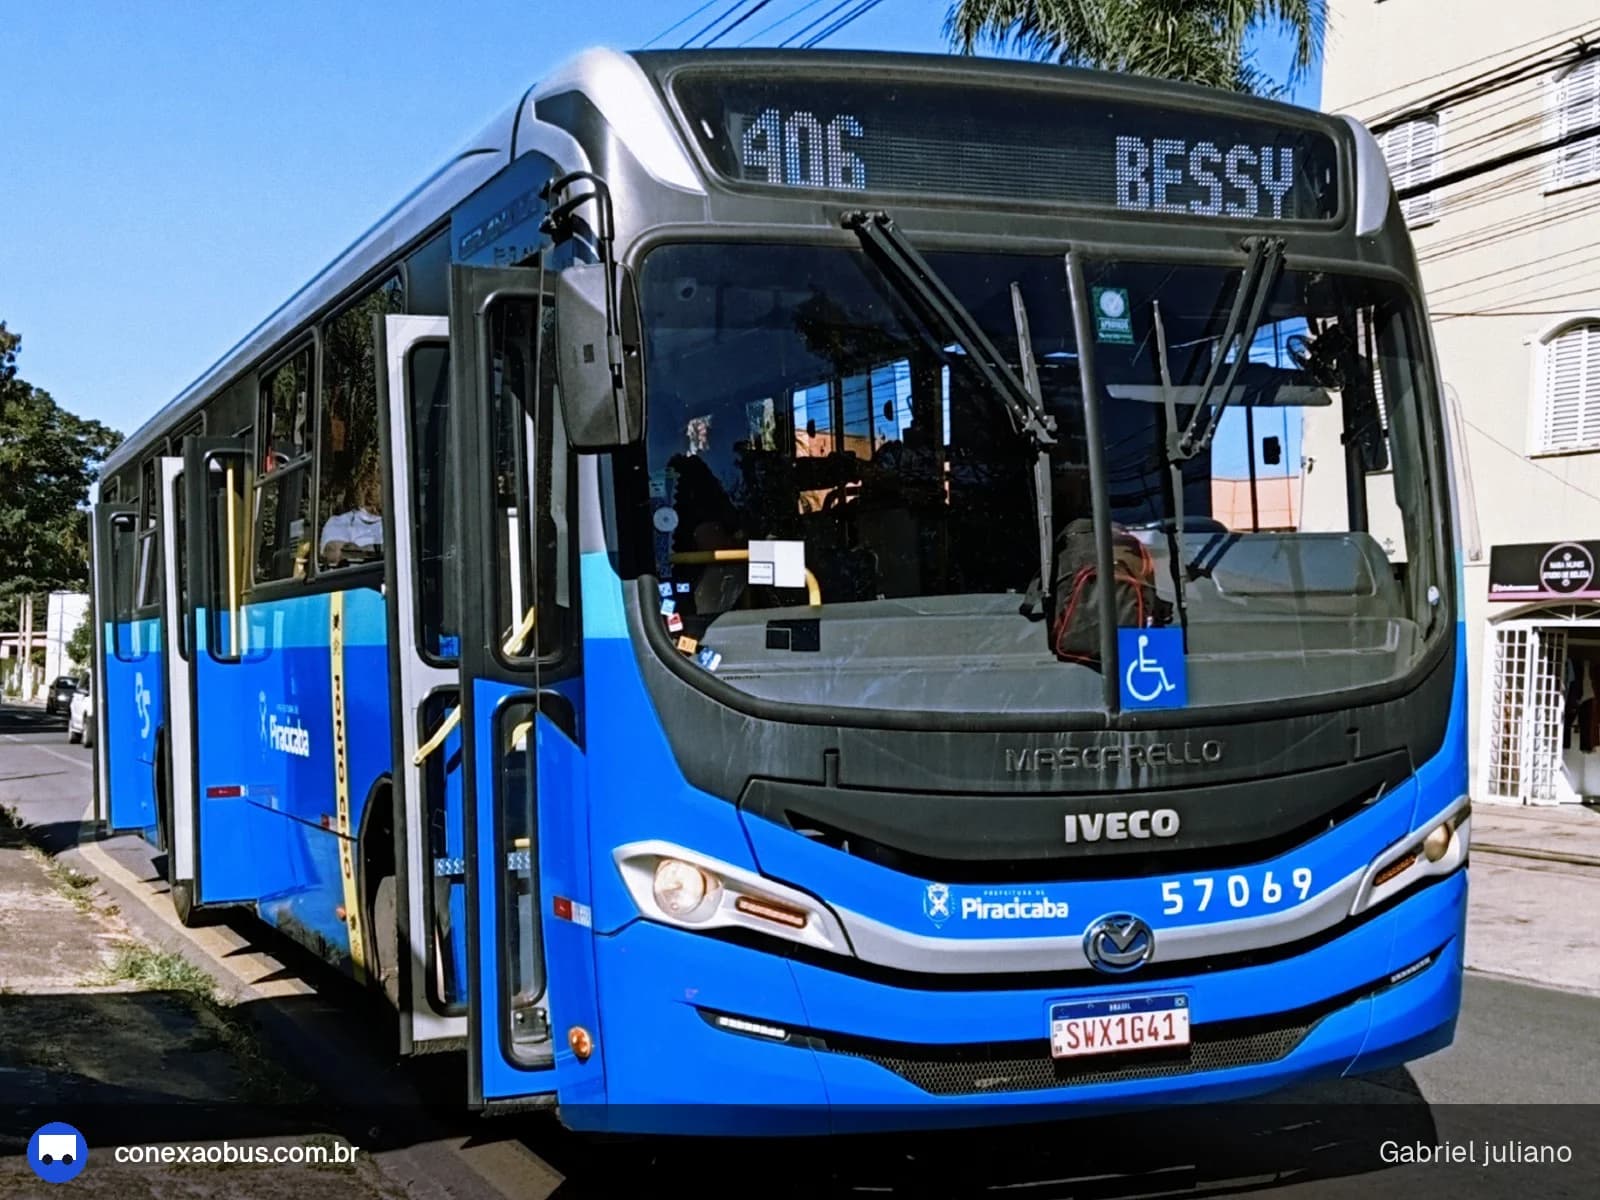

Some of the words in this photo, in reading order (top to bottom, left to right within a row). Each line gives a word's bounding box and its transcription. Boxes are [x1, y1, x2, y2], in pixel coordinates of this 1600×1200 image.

[743, 107, 866, 190] 406
[1116, 135, 1294, 220] BESSY
[269, 713, 310, 758] Piracicaba
[334, 674, 345, 784] PONTO
[1005, 740, 1222, 772] MASCARELLO
[1065, 808, 1181, 843] IVECO
[961, 896, 1069, 920] Piracicaba
[1161, 867, 1312, 915] 57069
[1066, 1012, 1176, 1049] SWX1G41
